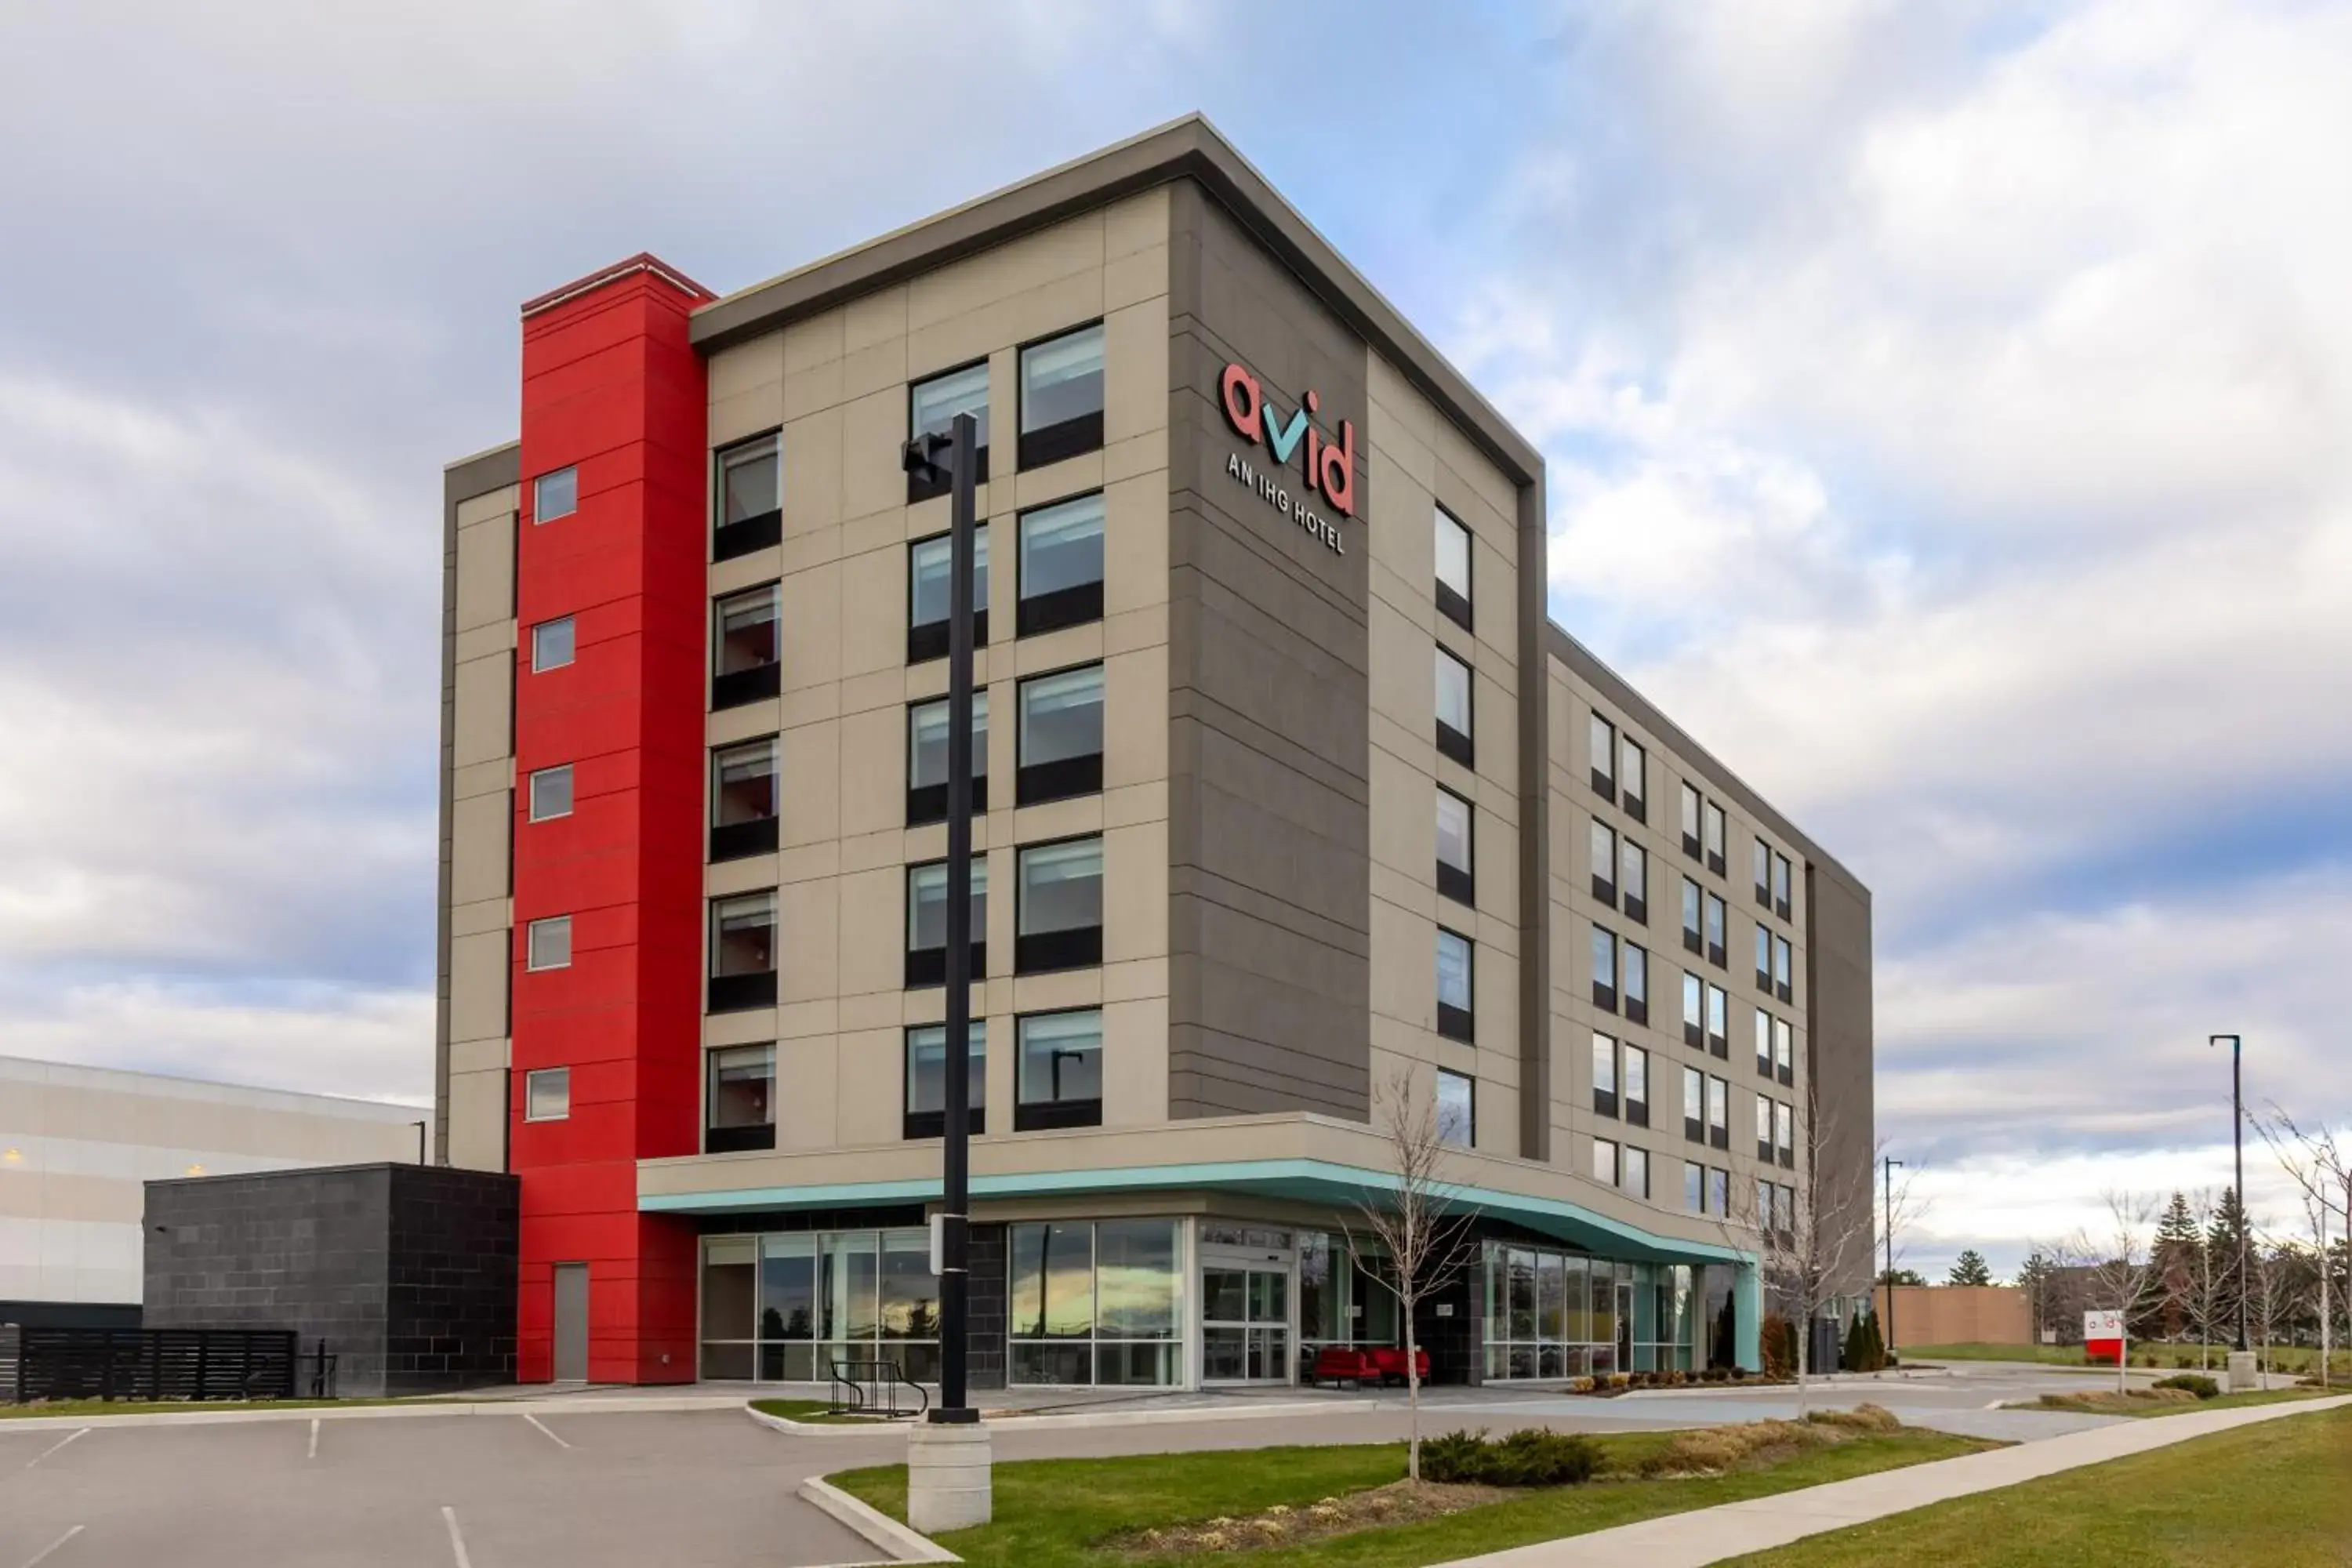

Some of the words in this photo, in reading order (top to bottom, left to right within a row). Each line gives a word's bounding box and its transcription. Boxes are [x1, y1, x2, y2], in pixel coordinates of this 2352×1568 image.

[1218, 363, 1353, 517] avid
[1228, 453, 1252, 486] AN
[1258, 474, 1288, 512] IHG
[1294, 502, 1345, 554] HOTEL
